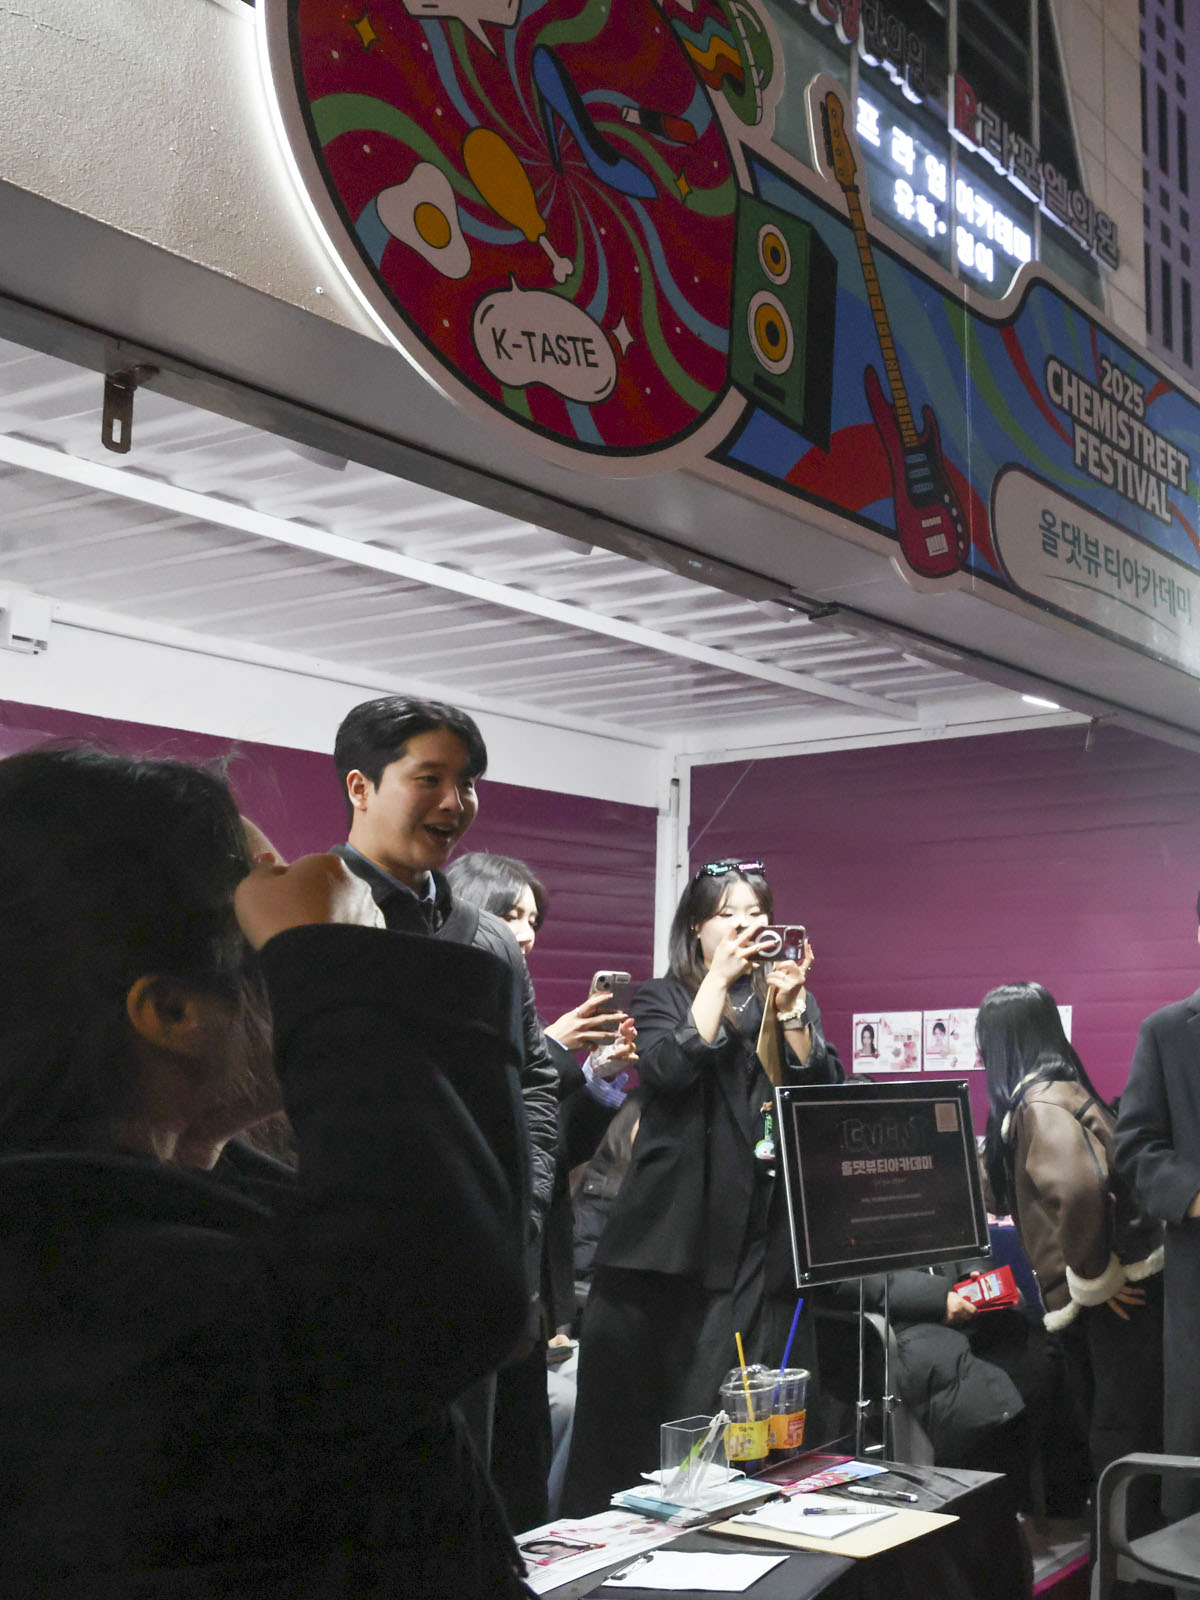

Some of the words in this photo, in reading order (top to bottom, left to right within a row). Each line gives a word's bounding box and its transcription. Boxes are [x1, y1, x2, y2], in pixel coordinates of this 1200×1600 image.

[491, 327, 600, 369] K-TASTE
[1101, 359, 1145, 416] 2025
[1047, 359, 1190, 493] CHEMISTREET
[1074, 423, 1172, 523] FESTIVAL
[1039, 507, 1192, 625] 올댓뷰티아카데미
